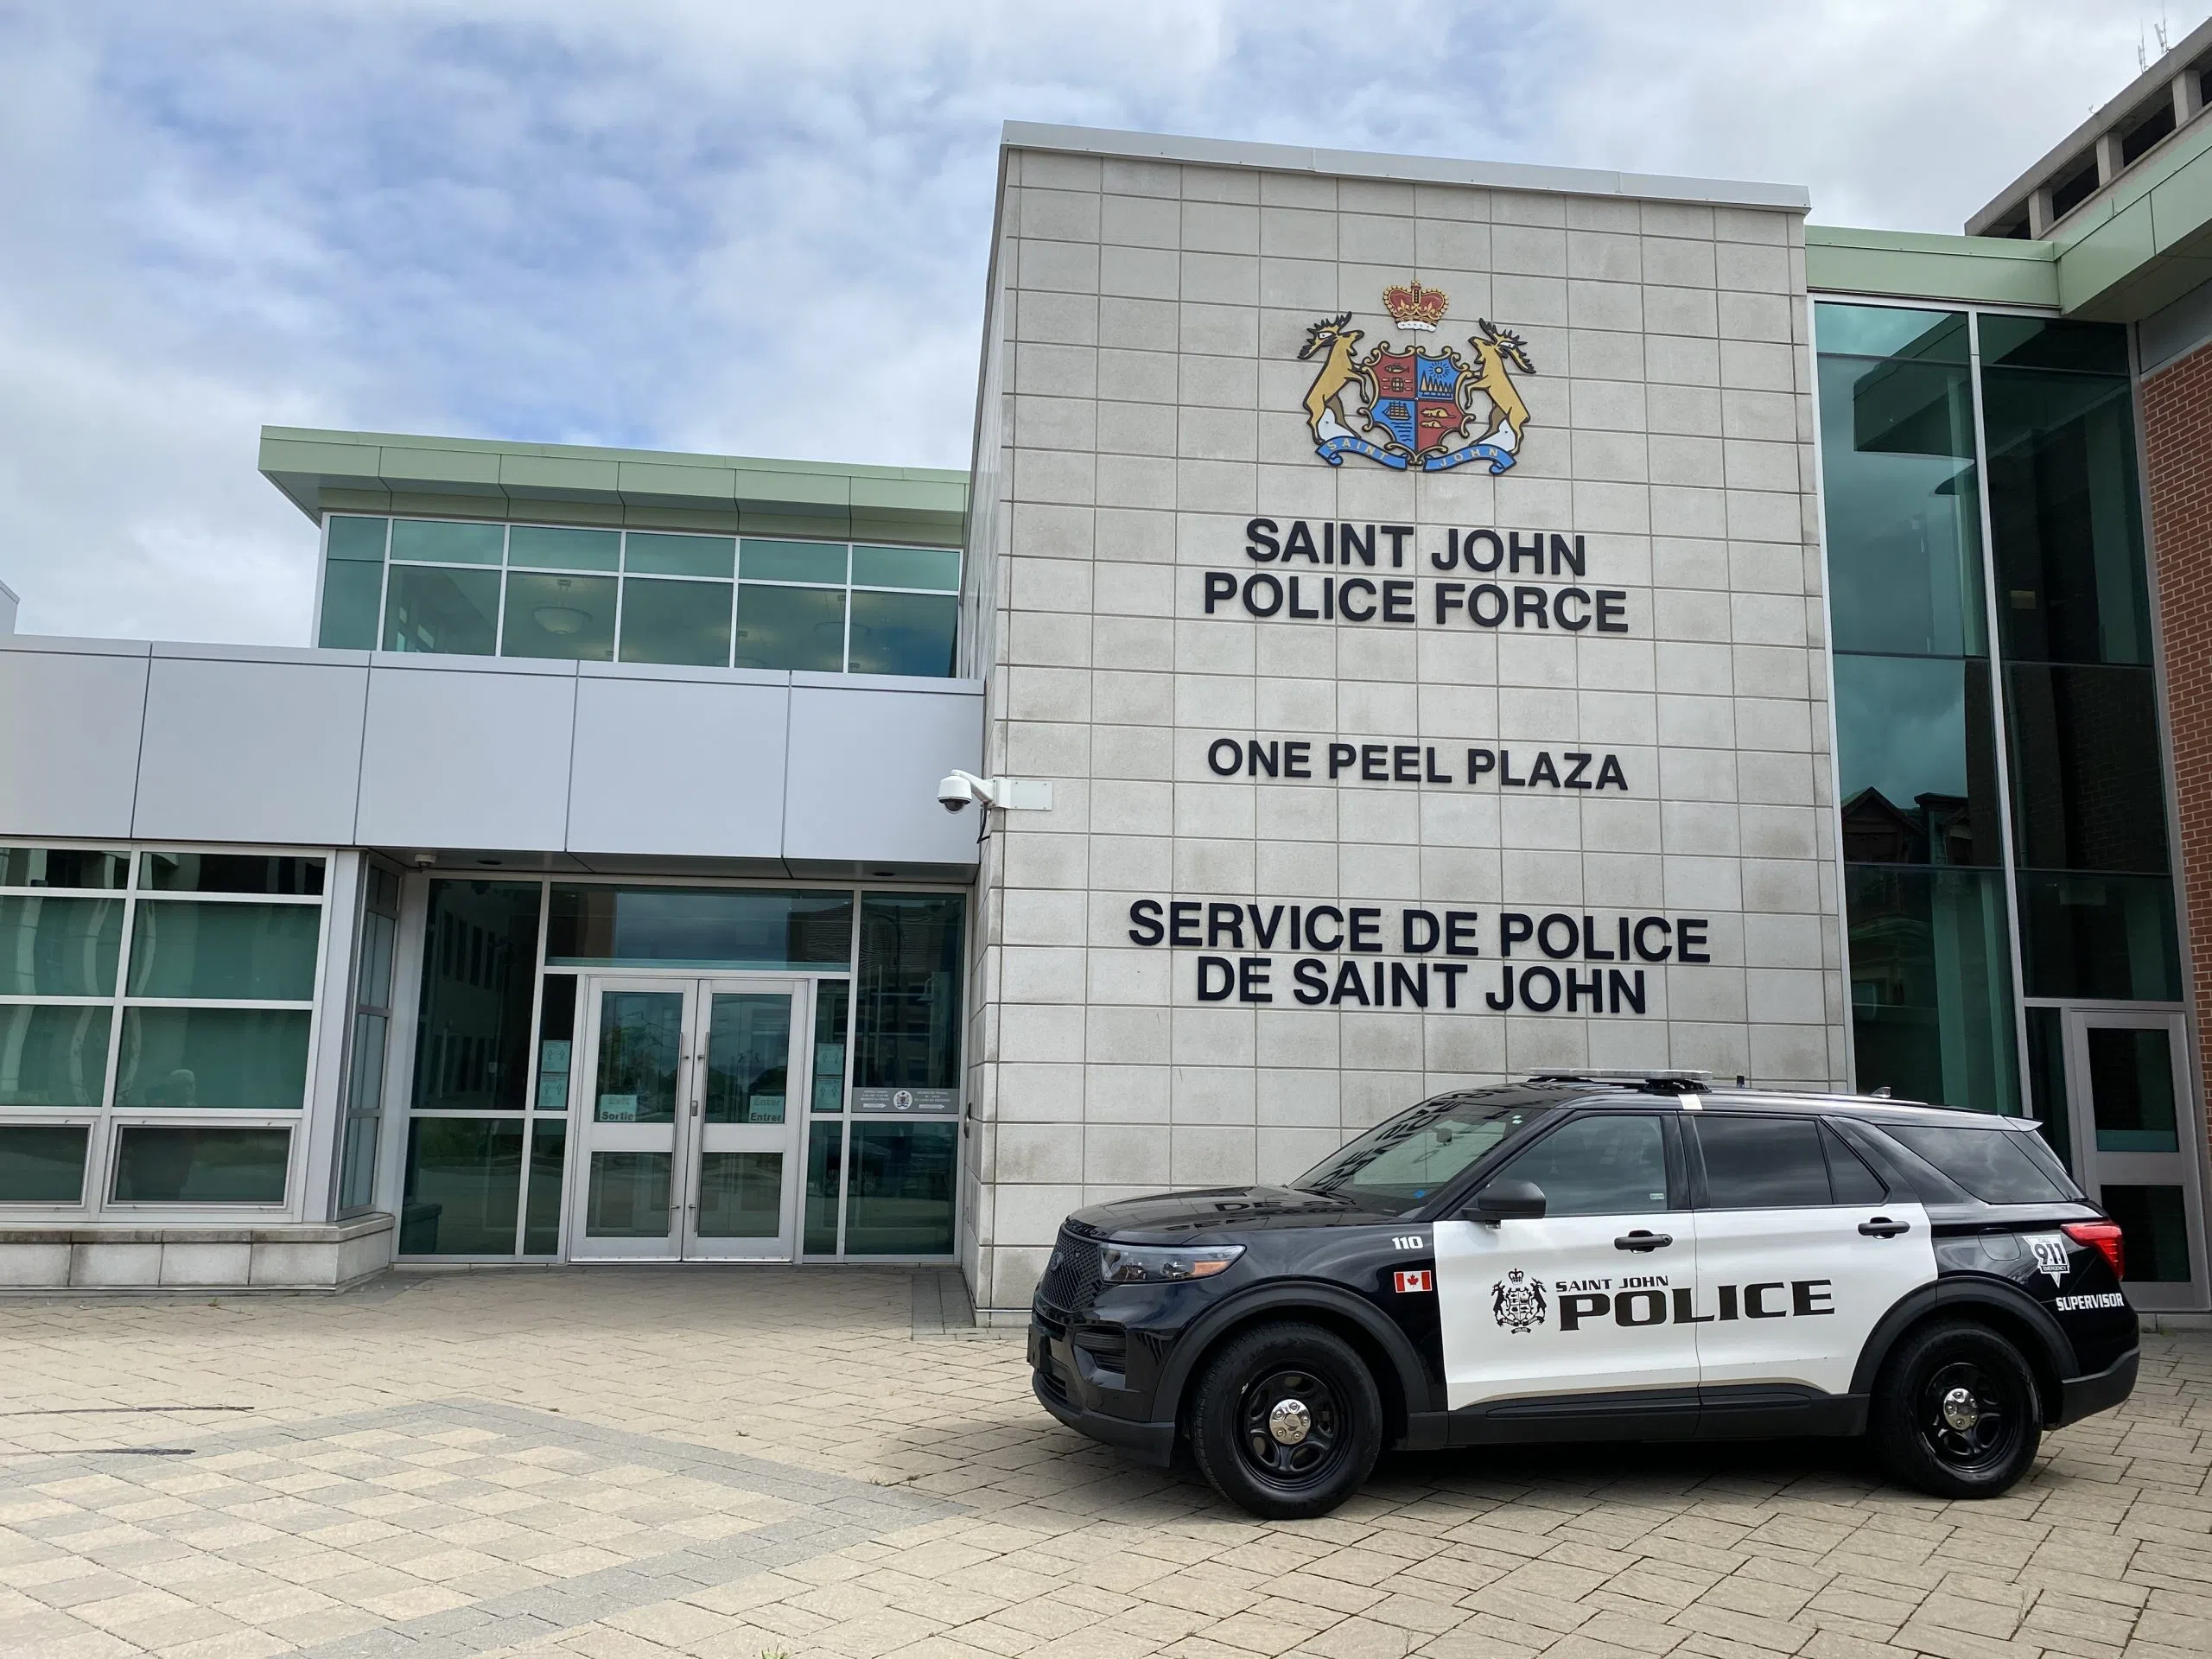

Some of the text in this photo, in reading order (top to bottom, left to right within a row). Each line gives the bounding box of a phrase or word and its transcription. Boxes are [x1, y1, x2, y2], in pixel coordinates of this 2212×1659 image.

[1326, 437, 1499, 467] SAINT JOHN
[1245, 518, 1586, 575] SAINT JOHN
[1205, 571, 1629, 633] POLICE FORCE
[1207, 738, 1629, 791] ONE PEEL PLAZA
[1128, 899, 1711, 963] SERVICE DE POLICE
[1197, 956, 1646, 1014] DE SAINT JOHN
[601, 1111, 634, 1121] Sortie
[750, 1112, 782, 1122] Entrer
[753, 1097, 781, 1107] Enter
[1391, 1236, 1424, 1250] 110
[1555, 1275, 1669, 1293] SAINT JOHN
[1558, 1279, 1835, 1332] POLICE
[2055, 1292, 2125, 1312] SUPERVISOR
